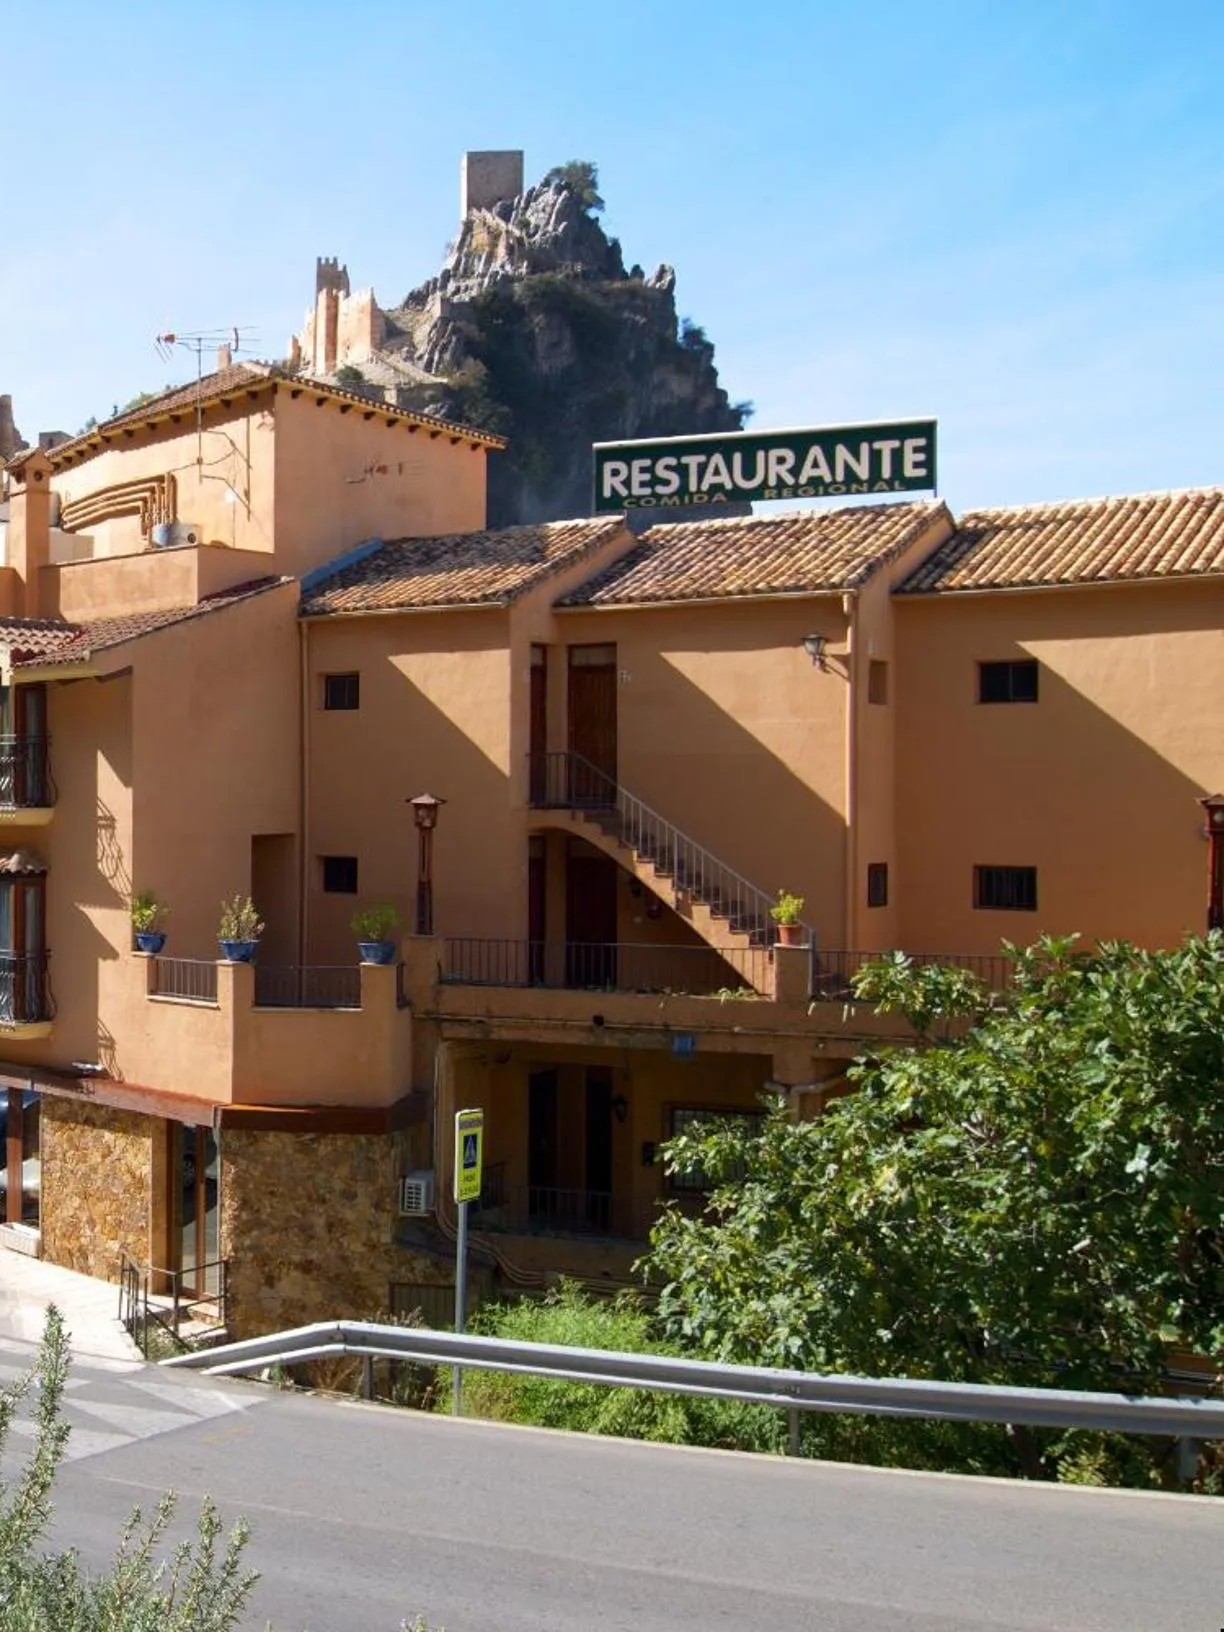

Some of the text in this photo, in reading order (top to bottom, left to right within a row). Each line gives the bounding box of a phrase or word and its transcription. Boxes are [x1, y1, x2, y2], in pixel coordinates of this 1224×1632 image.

[602, 438, 927, 498] RESTAURANTE
[623, 480, 906, 508] COMIDA REGIONAL
